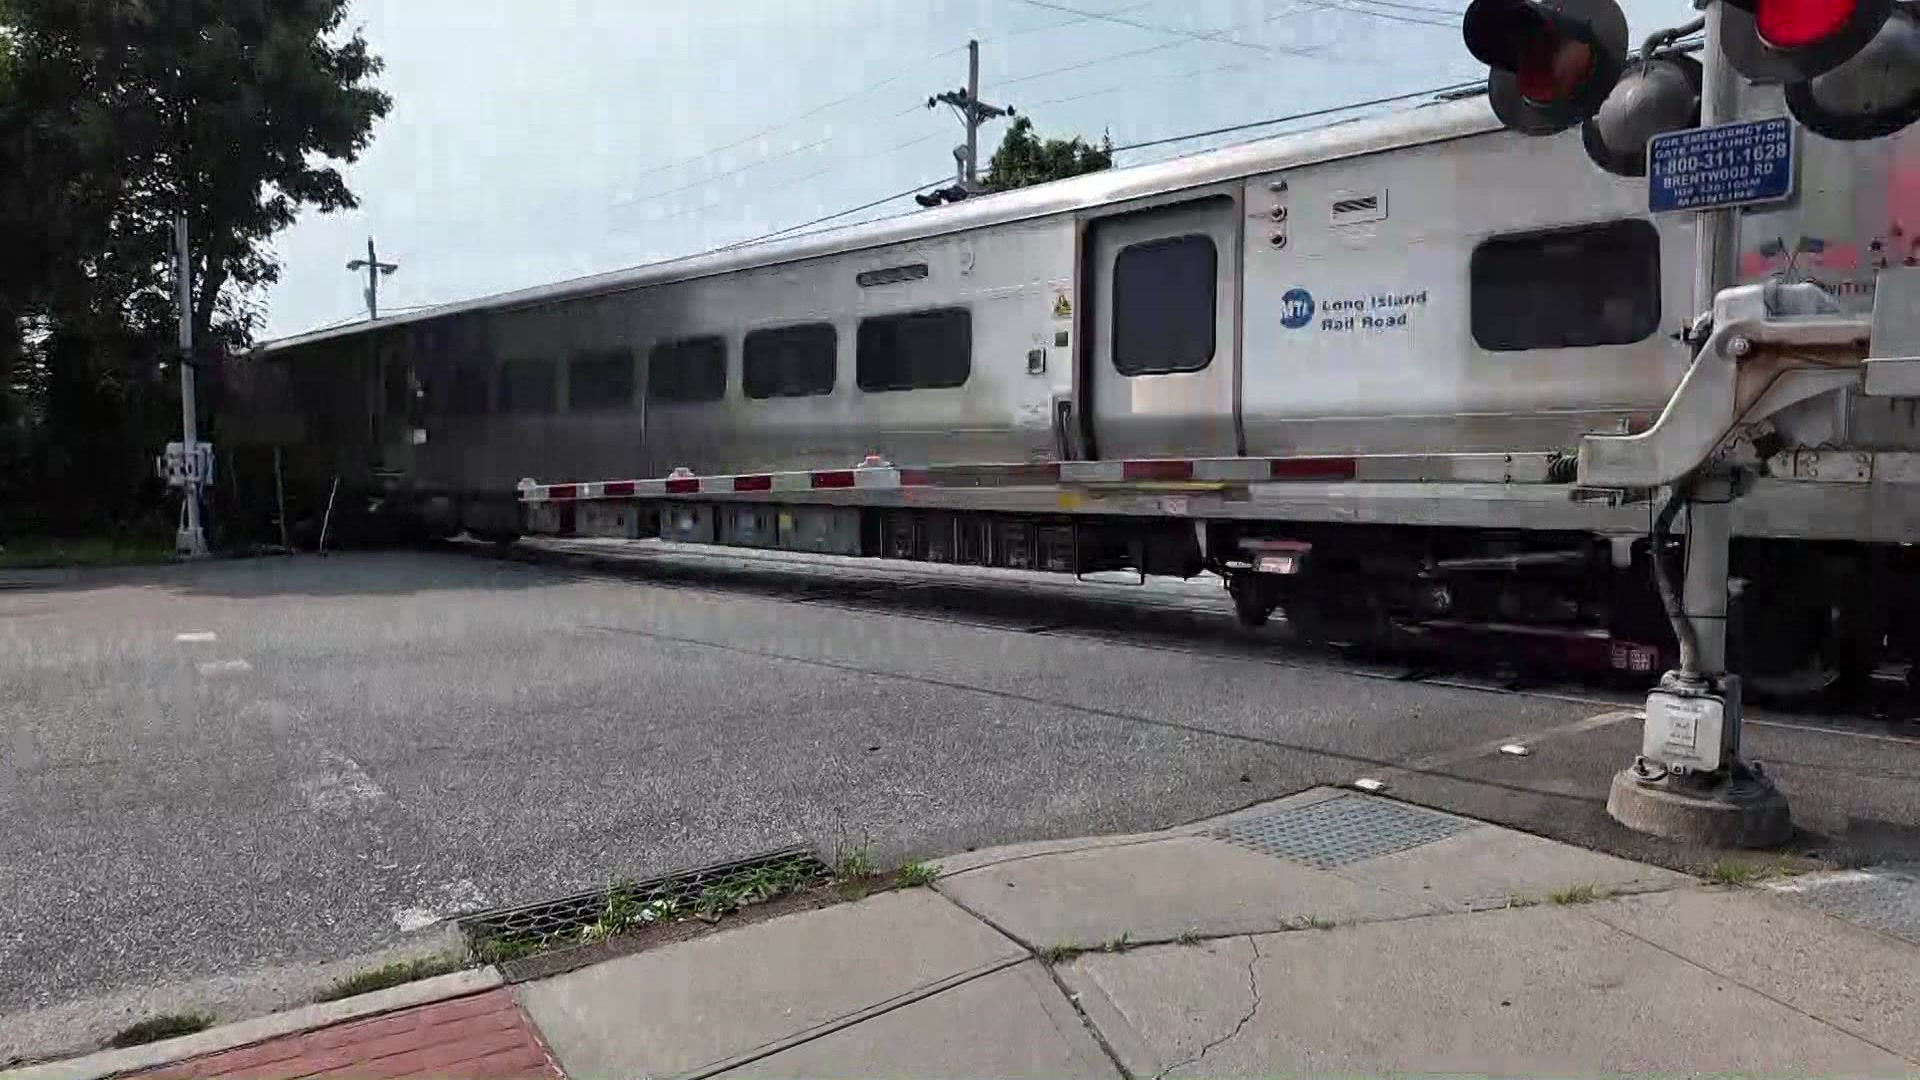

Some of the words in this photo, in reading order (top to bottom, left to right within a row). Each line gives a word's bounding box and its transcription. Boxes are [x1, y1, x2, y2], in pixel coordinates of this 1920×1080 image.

[1655, 137, 1679, 149] FOR
[1683, 125, 1761, 144] EMERGENCY
[1767, 121, 1785, 132] OR
[1655, 147, 1686, 159] GATE
[1690, 132, 1785, 153] MALFUNCTION
[1653, 141, 1787, 176] 1-800-311-1628
[1663, 165, 1749, 189] BRENTWOOD
[1754, 162, 1773, 176] RD
[1322, 299, 1365, 312] Long
[1371, 291, 1427, 309] Island
[1322, 316, 1354, 331] Rail
[1361, 313, 1407, 329] Road
